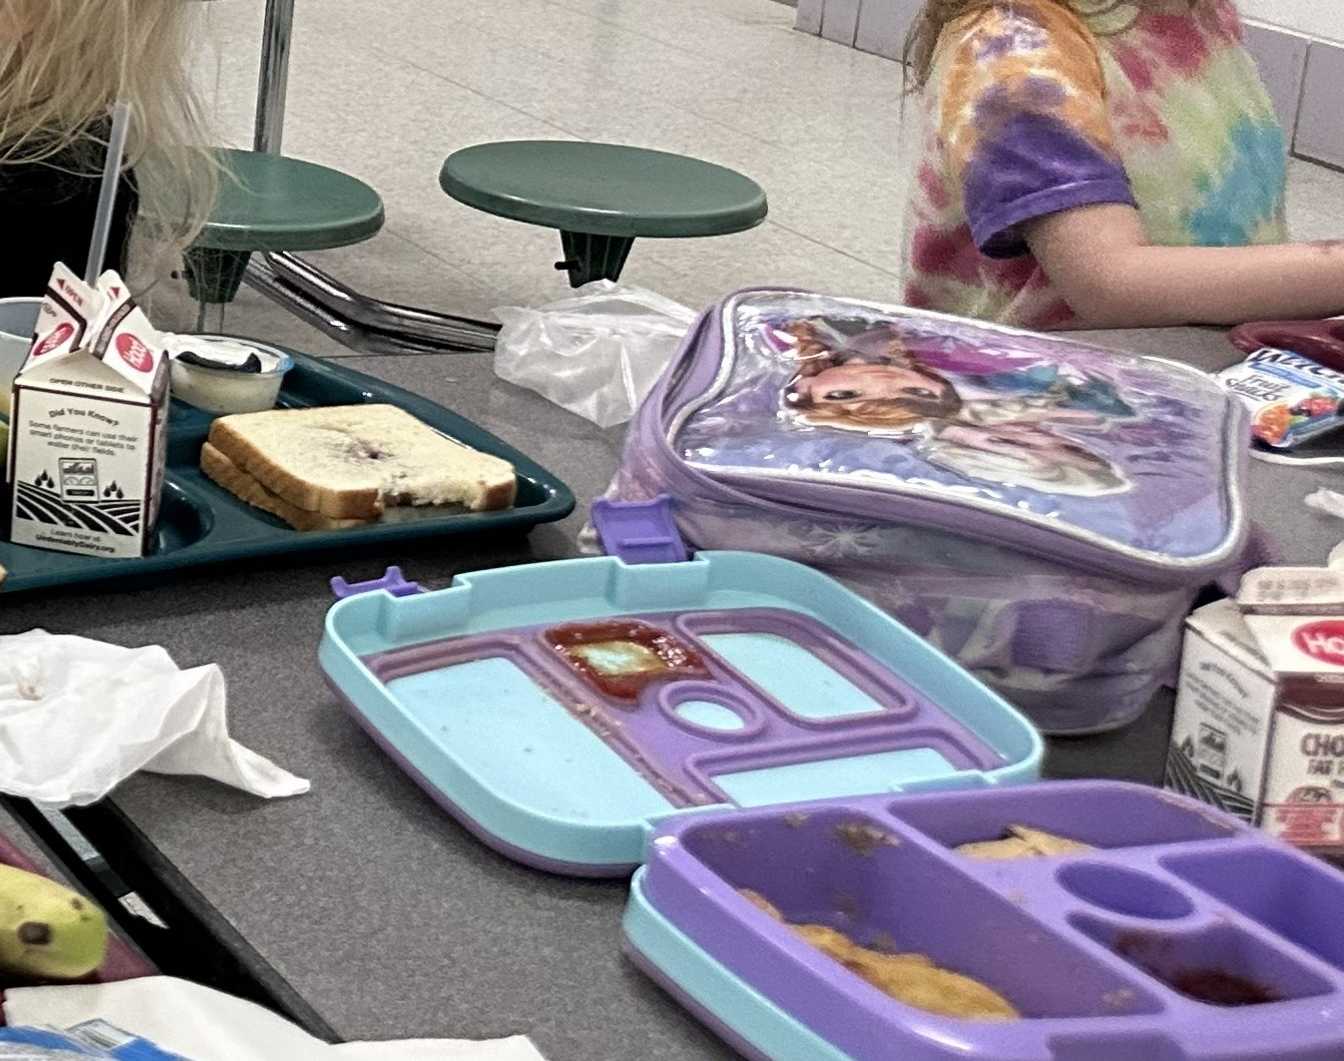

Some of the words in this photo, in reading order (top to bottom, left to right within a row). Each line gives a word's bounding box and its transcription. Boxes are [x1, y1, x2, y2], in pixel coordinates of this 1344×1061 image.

[49, 378, 73, 387] OPEN
[74, 379, 103, 390] OTHER
[48, 408, 65, 418] Did
[66, 407, 86, 416] You
[87, 409, 120, 426] Know?
[29, 420, 51, 430] Some
